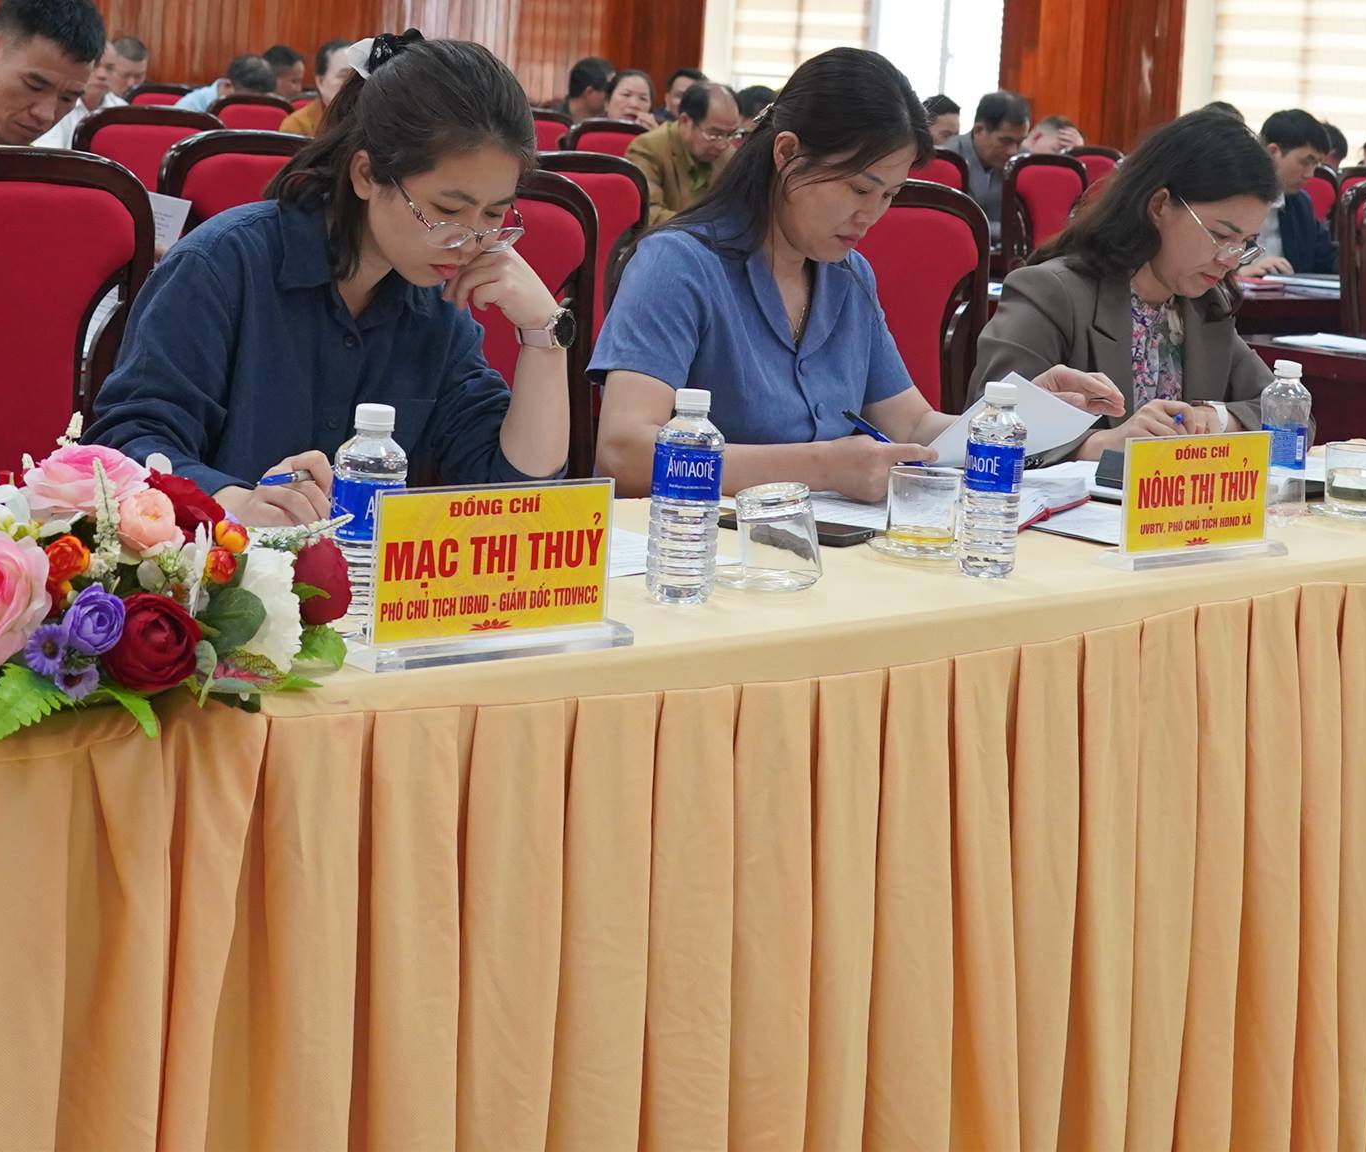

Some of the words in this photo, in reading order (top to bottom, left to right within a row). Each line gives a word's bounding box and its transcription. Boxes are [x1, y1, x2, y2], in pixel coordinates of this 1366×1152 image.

[1175, 444, 1207, 460] ĐỒNG
[1211, 443, 1230, 458] CHÍ
[1138, 469, 1186, 509] NÔNG
[1191, 473, 1216, 510] THỊ
[1220, 457, 1259, 502] THỦY
[449, 495, 502, 517] ĐỒNG
[509, 494, 541, 514] CHÍ
[1168, 519, 1183, 533] PHÓ
[1185, 515, 1200, 531] CHỦ
[1202, 517, 1218, 531] TỊCH
[383, 538, 459, 588] MẠC
[470, 534, 517, 581] THỊ
[528, 512, 604, 571] THUỶ
[380, 597, 404, 622] PHÓ
[406, 591, 429, 620] CHỦ
[432, 598, 456, 622] TỊCH
[459, 594, 489, 615] UBND
[499, 588, 527, 612] GIÁM
[530, 582, 550, 609] ĐỐC
[554, 585, 598, 607] TTDVHCC
